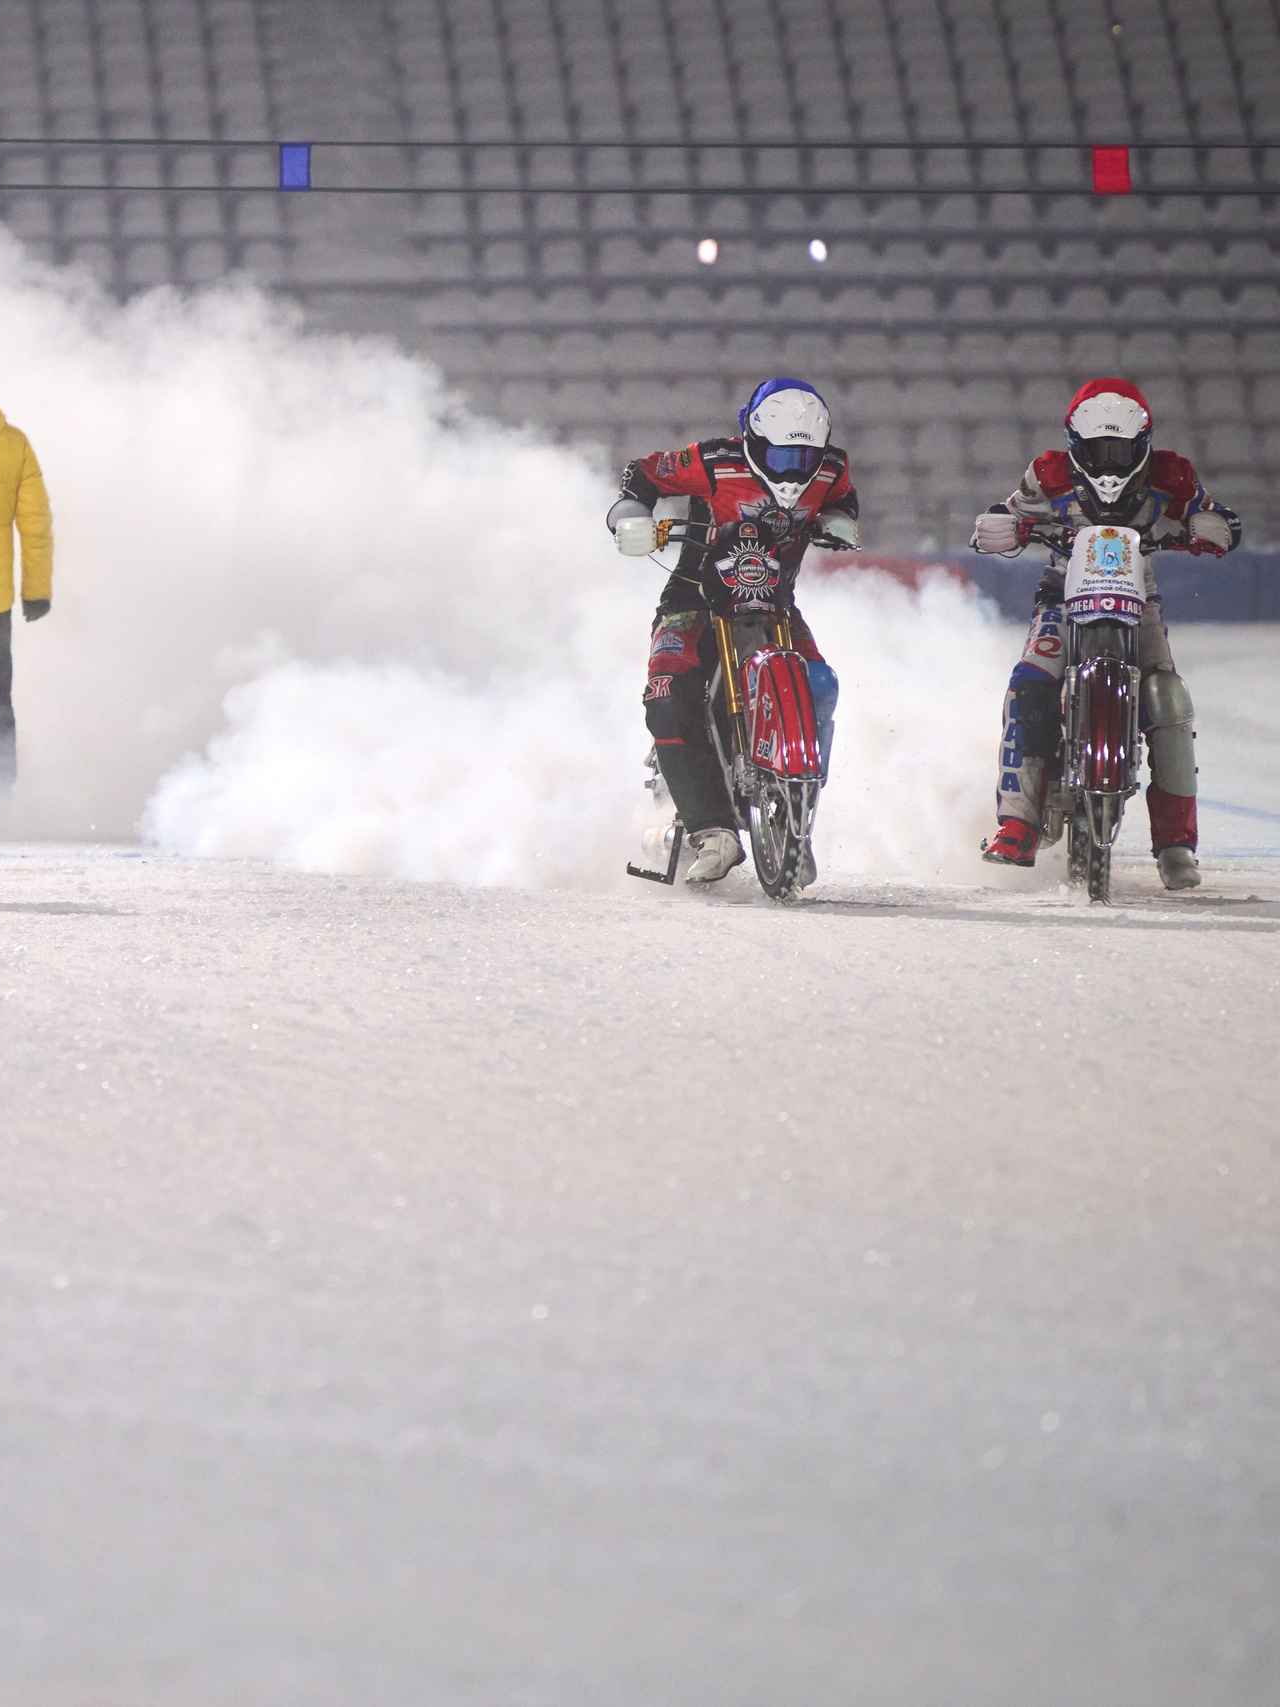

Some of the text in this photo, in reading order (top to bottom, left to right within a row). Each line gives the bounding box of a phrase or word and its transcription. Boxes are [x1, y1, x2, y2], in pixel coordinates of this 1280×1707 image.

[789, 432, 811, 440] SHOEI
[1082, 579, 1134, 587] Правительство
[1076, 585, 1139, 595] Самарской области
[644, 675, 673, 700] SR
